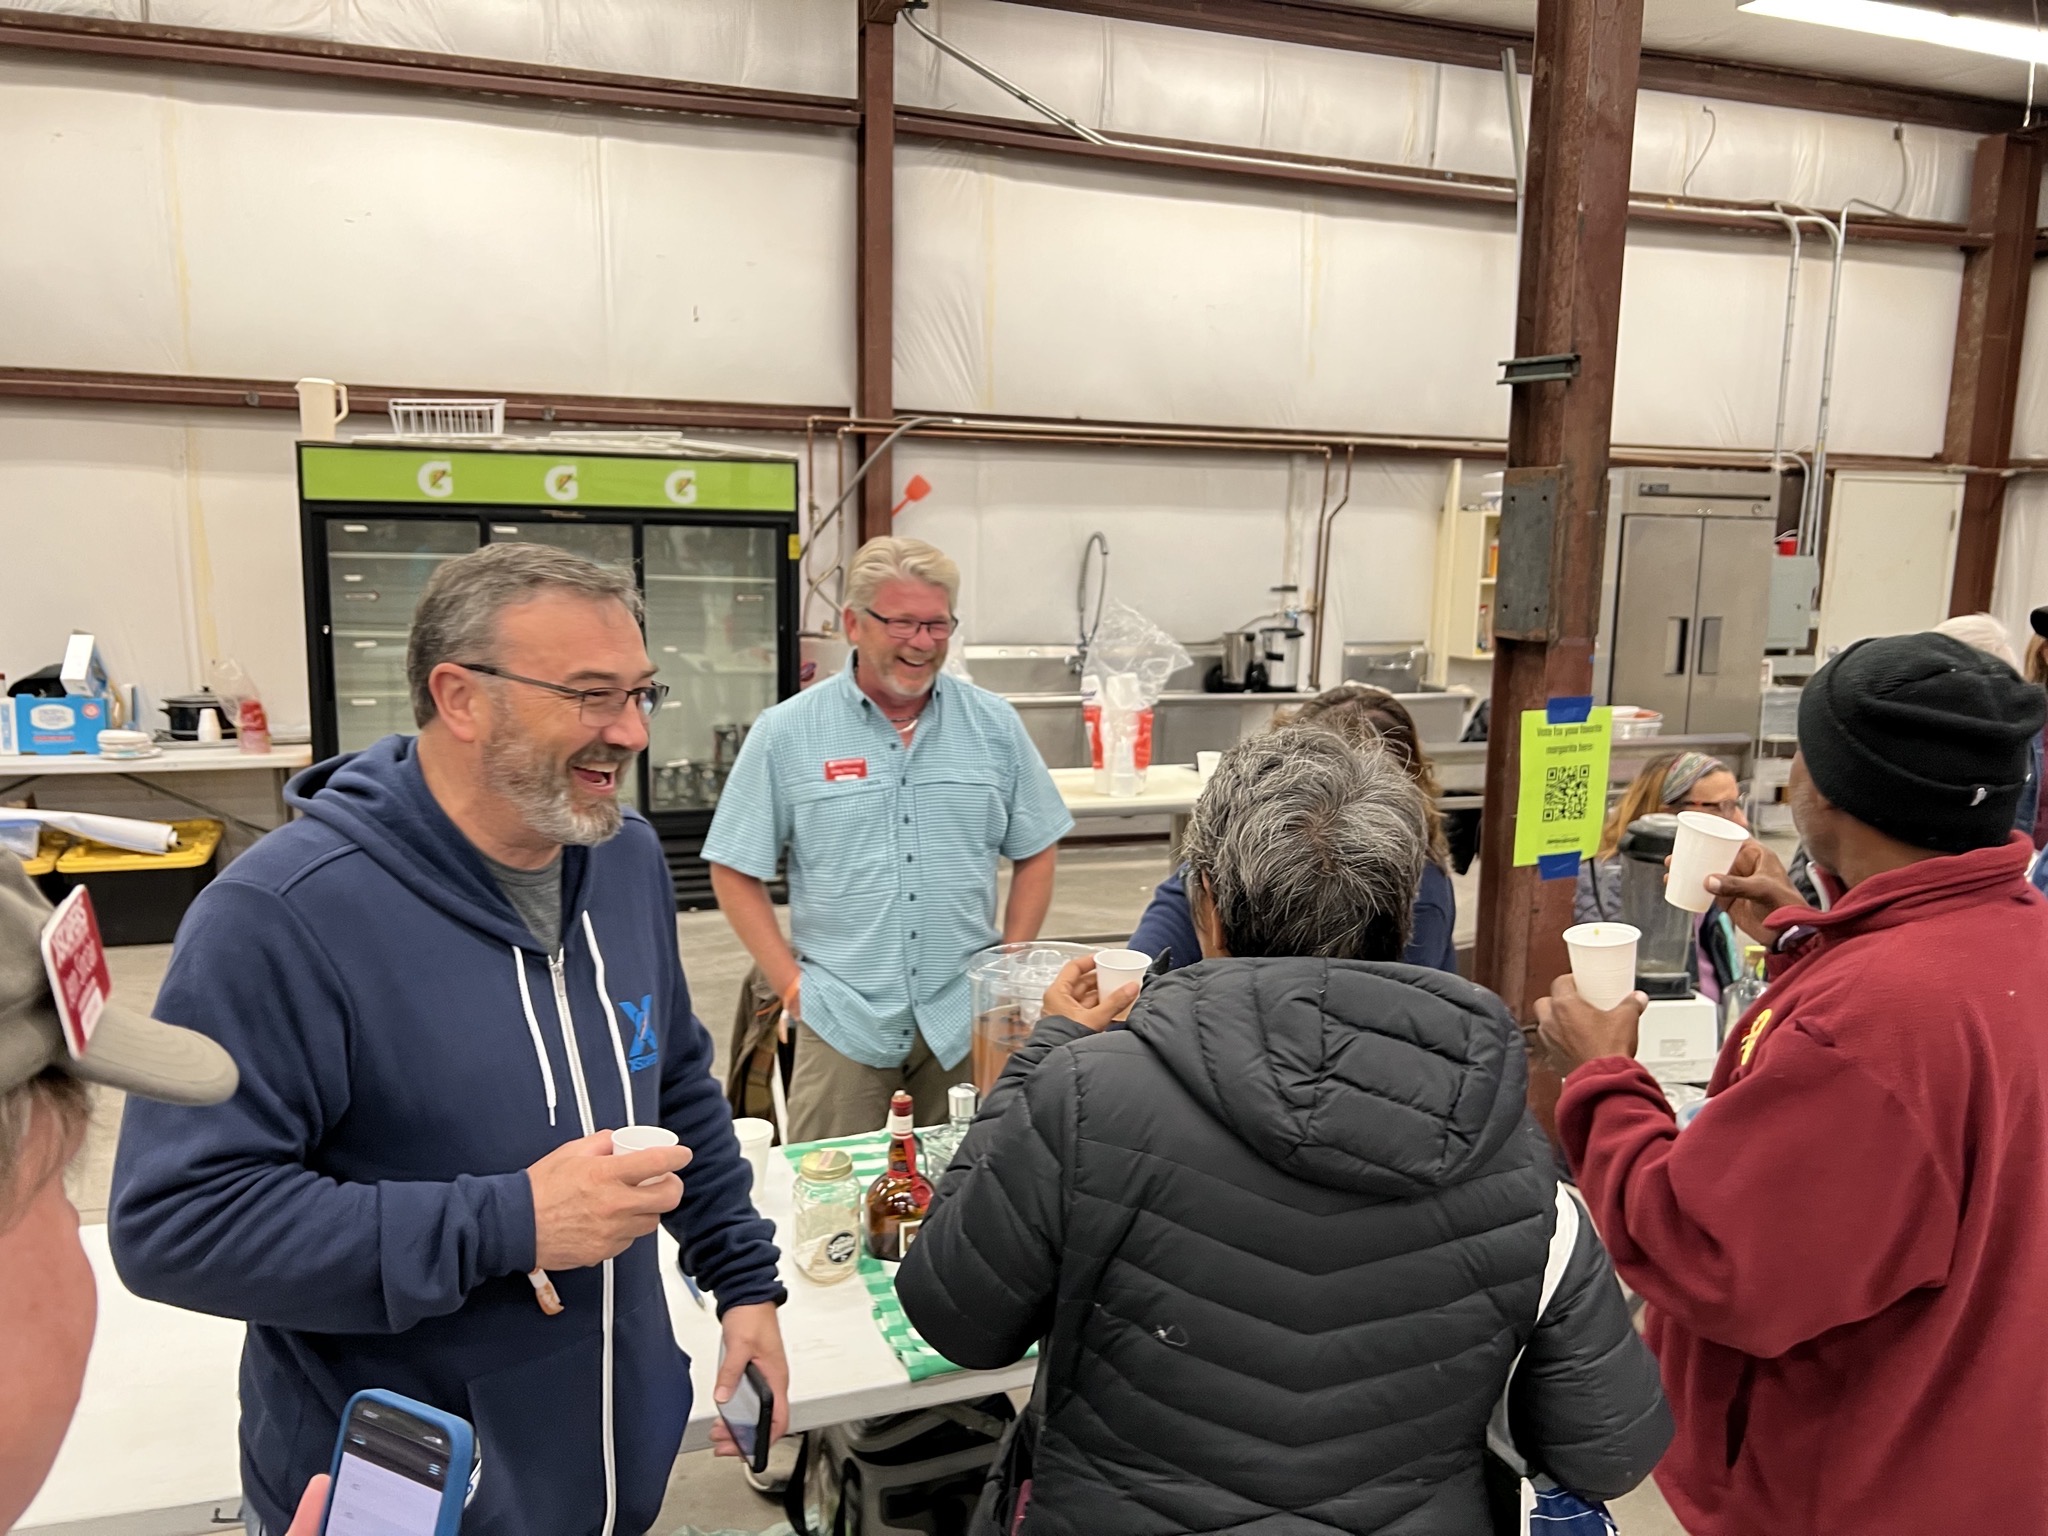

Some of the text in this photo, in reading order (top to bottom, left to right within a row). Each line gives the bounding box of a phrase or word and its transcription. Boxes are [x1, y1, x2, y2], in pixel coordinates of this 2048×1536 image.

[417, 461, 453, 498] G
[544, 465, 578, 501] G
[665, 470, 697, 504] G
